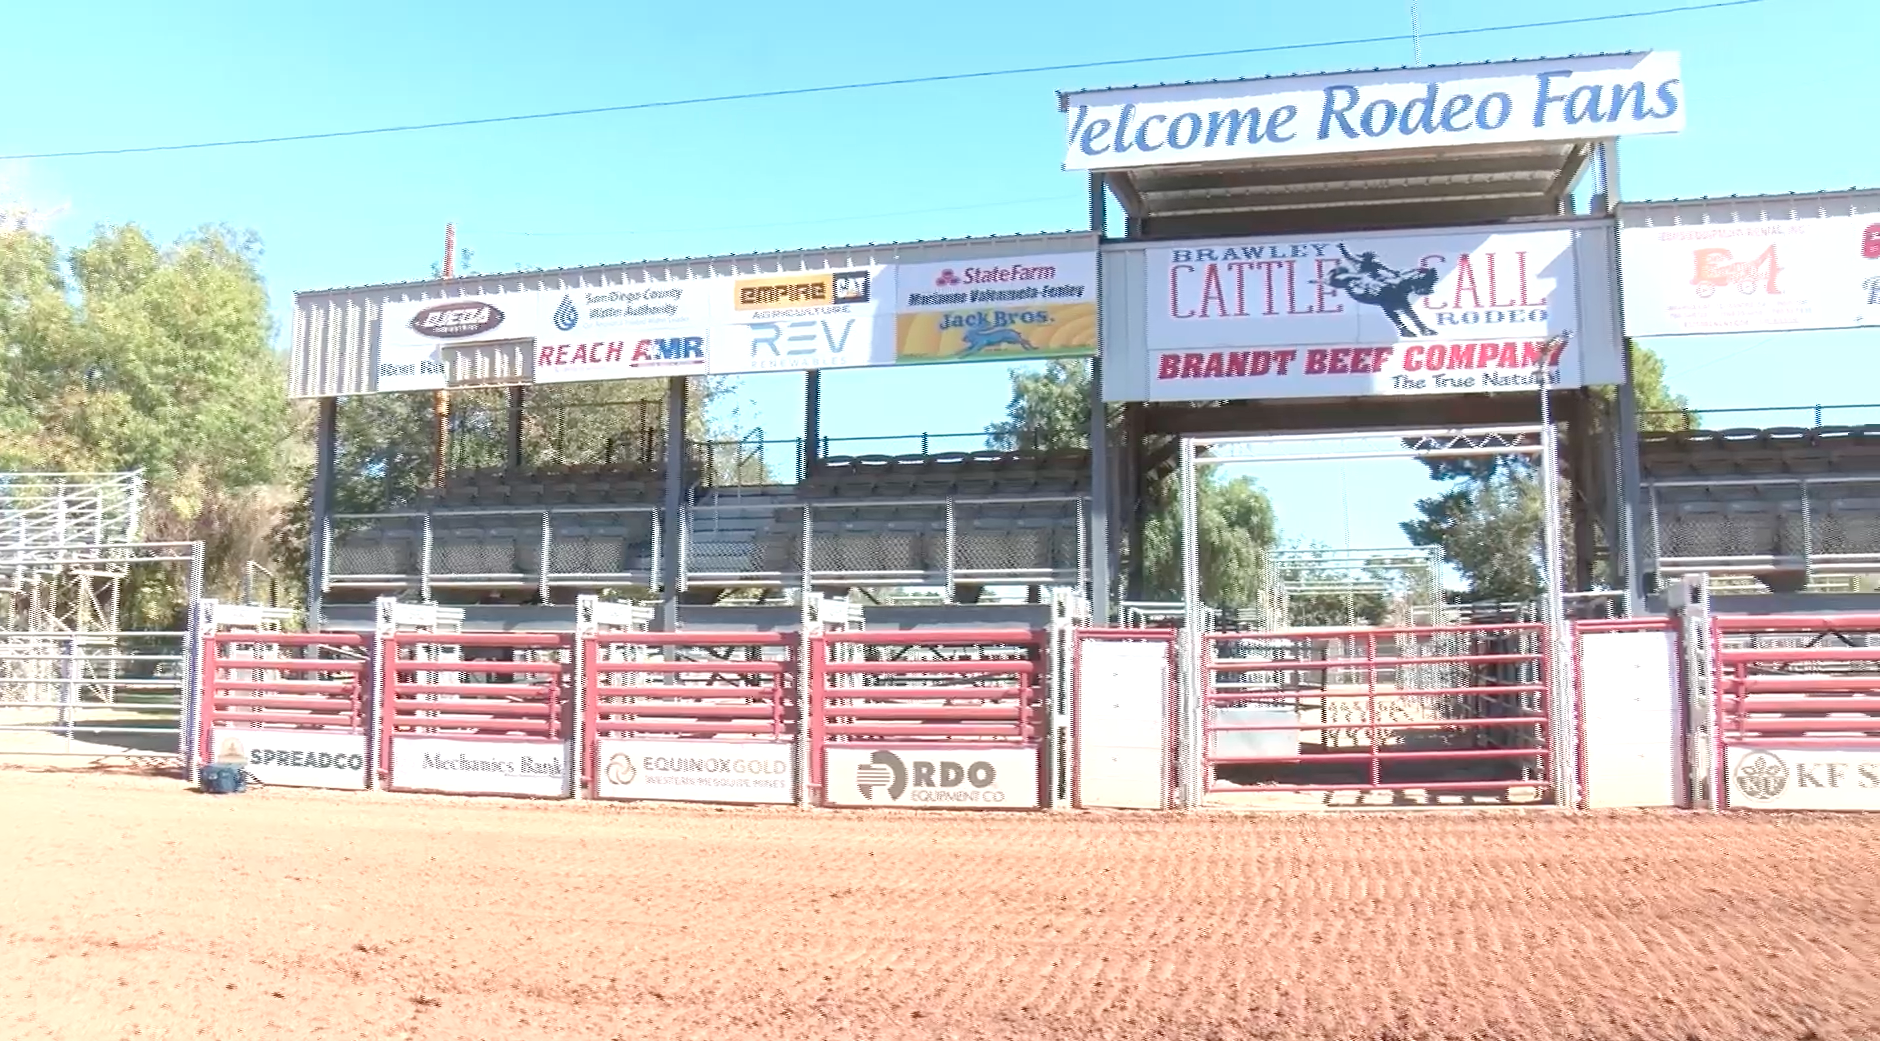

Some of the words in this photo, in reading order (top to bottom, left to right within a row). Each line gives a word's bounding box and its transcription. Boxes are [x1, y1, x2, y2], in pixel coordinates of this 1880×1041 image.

[1317, 82, 1513, 139] Rodeo
[1532, 69, 1680, 127] Fans
[1171, 243, 1330, 262] BRAWLEY
[834, 273, 869, 299] CAT
[1170, 257, 1344, 318] CATTLE
[1419, 251, 1547, 311] CALL
[584, 292, 607, 305] San
[608, 290, 642, 306] Diego
[643, 287, 684, 302] County
[907, 289, 968, 307] Marianne
[588, 306, 623, 320] Water
[623, 301, 679, 319] Authority
[751, 304, 852, 320] AGRICULTURE
[939, 311, 987, 330] Jack
[990, 309, 1056, 328] Bros.
[1435, 308, 1549, 326] RODEO
[750, 318, 856, 357] REV
[537, 340, 625, 367] REACH
[630, 336, 706, 361] AMR
[751, 355, 848, 369] RENEWABLES
[1157, 350, 1296, 380] BRANDT
[1304, 346, 1394, 375] BEEF
[1403, 339, 1569, 372] COMPANY
[380, 363, 416, 377] Ron
[1392, 373, 1427, 389] The
[1432, 373, 1476, 388] True
[249, 748, 364, 771] SPREADCO
[422, 752, 515, 773] Mechanics
[520, 755, 563, 774] Bank
[912, 760, 998, 789] RDO
[1795, 762, 1849, 788] KF
[910, 790, 980, 802] EQUIPMENT
